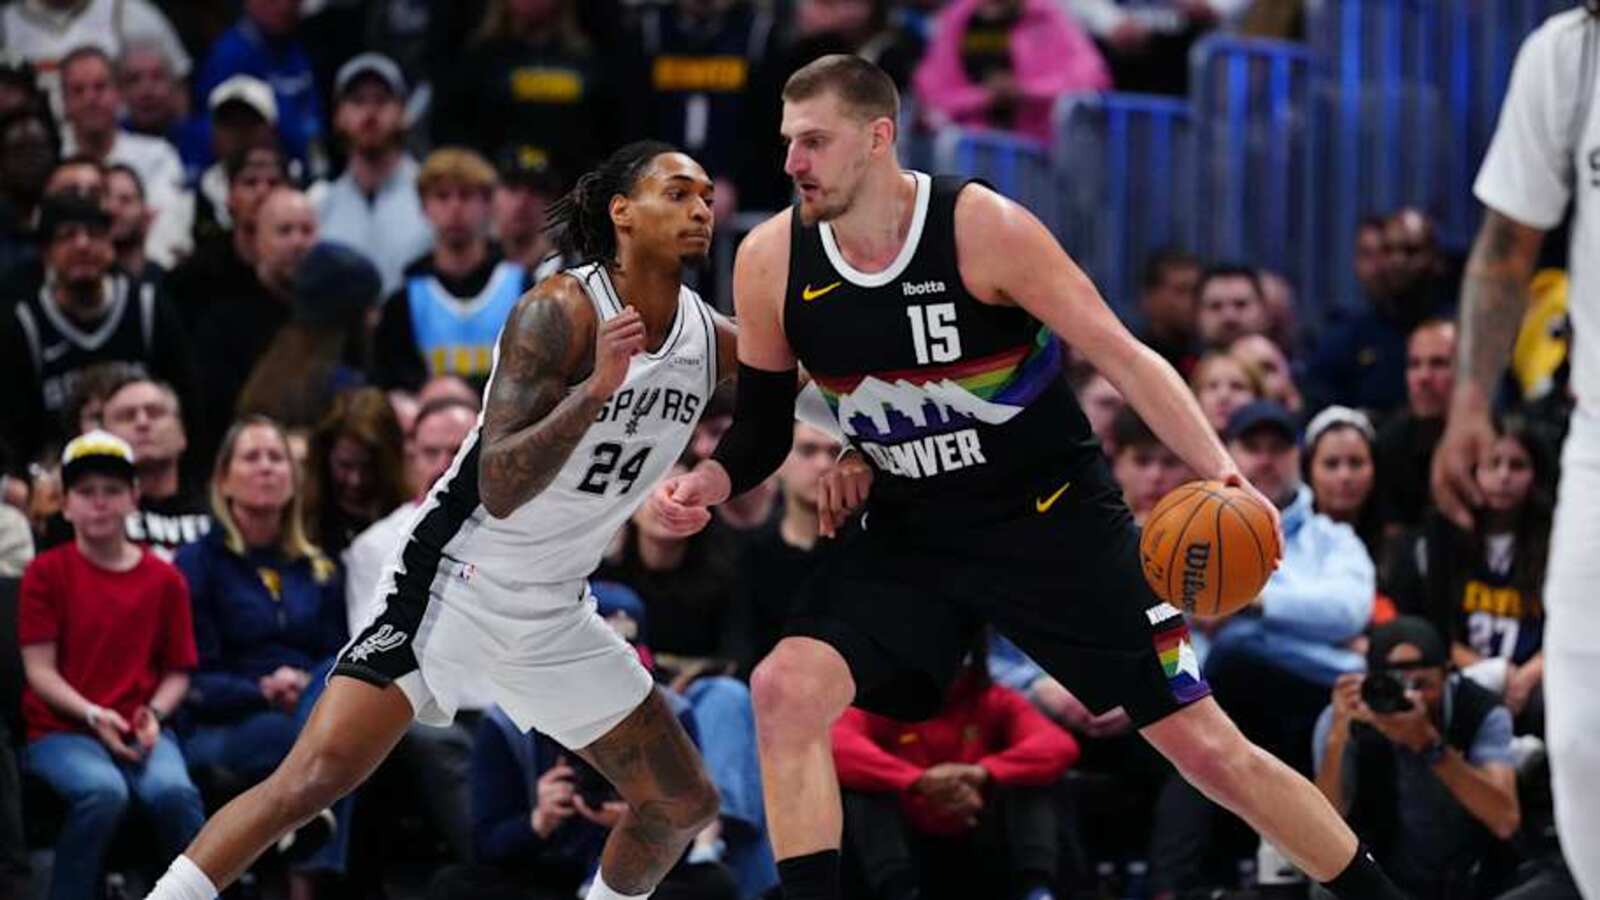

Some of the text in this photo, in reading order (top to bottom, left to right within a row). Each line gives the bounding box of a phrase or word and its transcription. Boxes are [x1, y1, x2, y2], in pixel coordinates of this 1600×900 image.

[902, 279, 946, 296] ibotta
[906, 302, 963, 365] 15
[576, 441, 654, 496] 24
[860, 427, 987, 479] DENVER
[1467, 610, 1520, 660] 27
